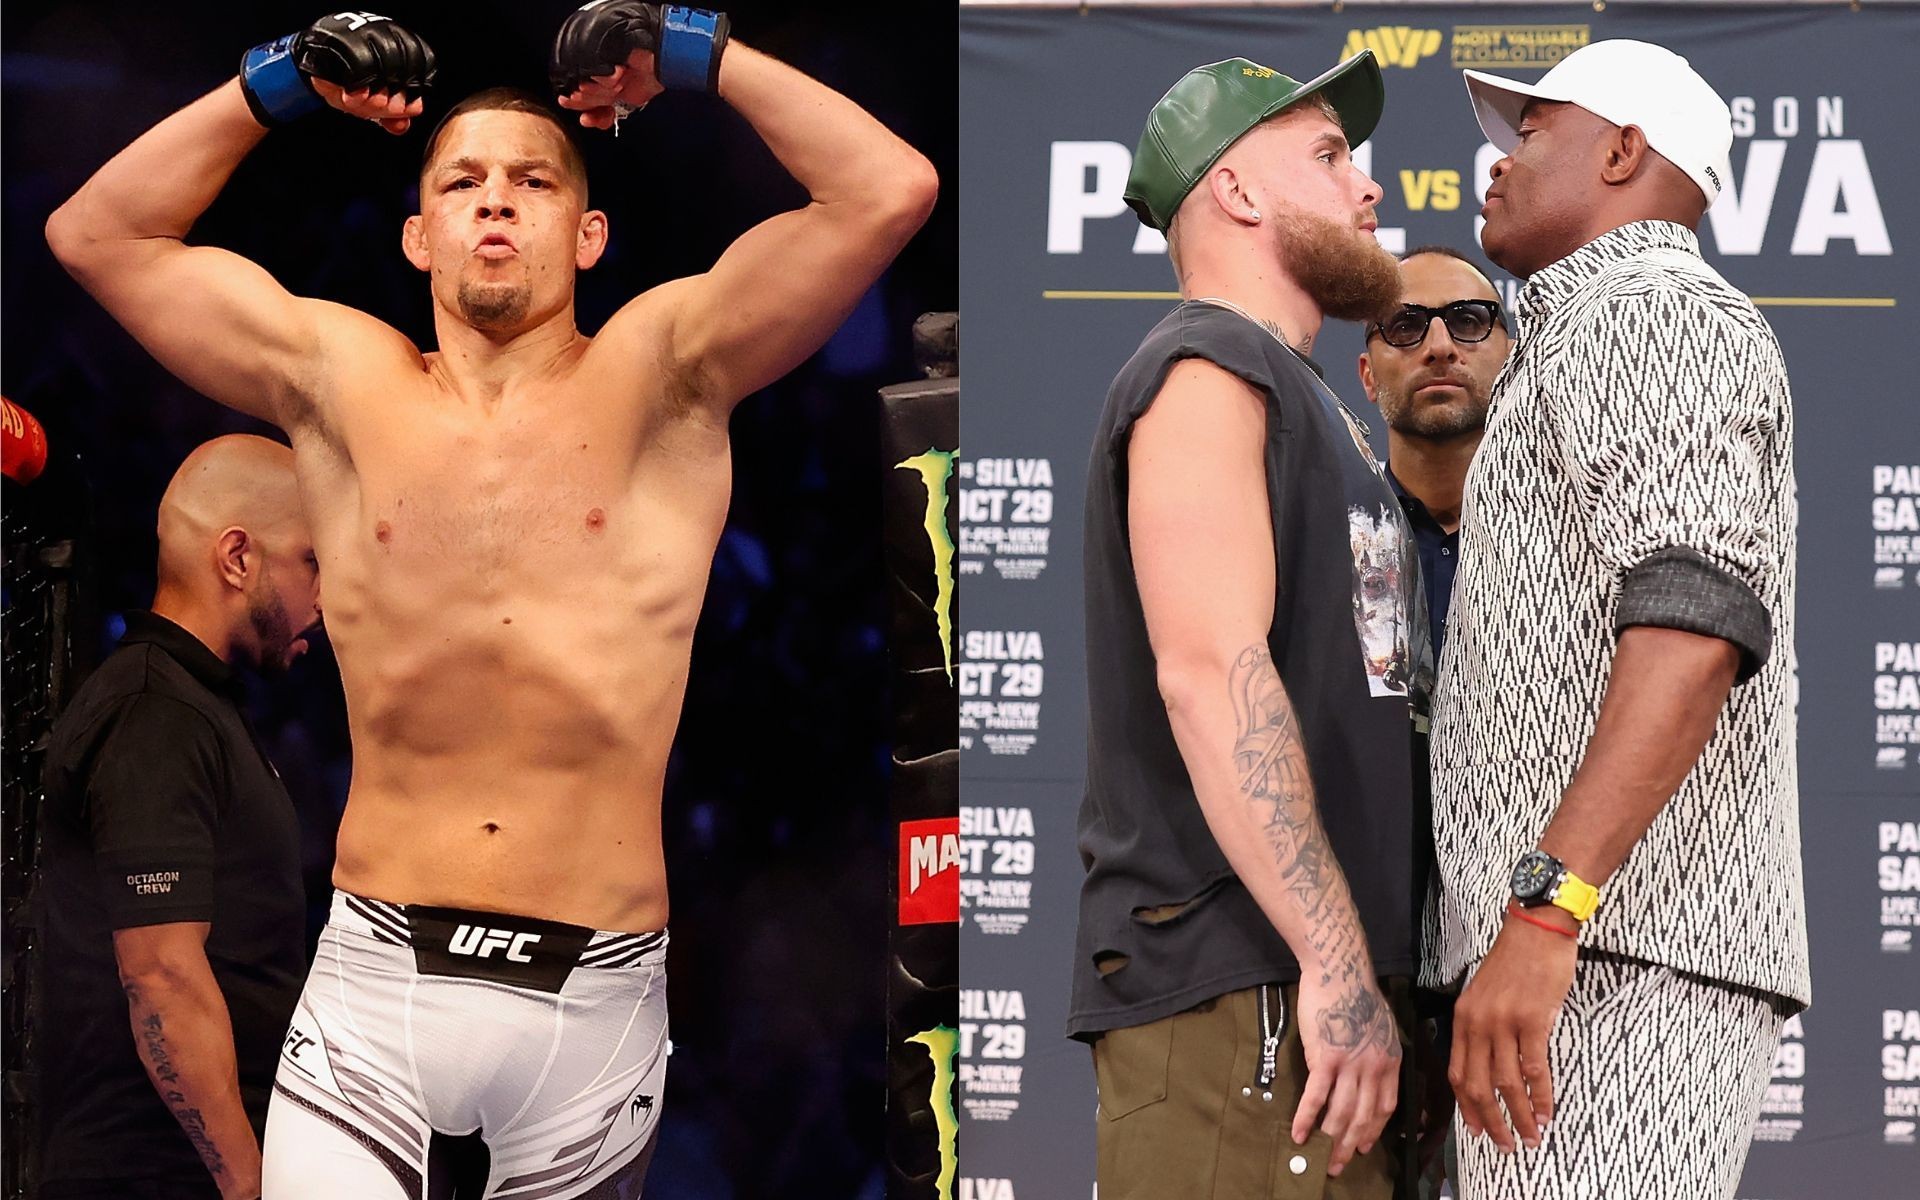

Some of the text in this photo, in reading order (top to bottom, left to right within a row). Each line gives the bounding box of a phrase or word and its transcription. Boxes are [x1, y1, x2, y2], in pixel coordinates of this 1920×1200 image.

[1452, 30, 1589, 45] MOST VALUABLE
[1400, 169, 1460, 212] VS
[976, 458, 1053, 487] SILVA
[1010, 489, 1053, 523] 29
[965, 630, 1044, 660] SILVA
[1000, 663, 1044, 697] 29
[960, 806, 1035, 836] SILVA
[991, 840, 1035, 874] 29
[127, 872, 179, 885] OCTAGON
[136, 883, 171, 895] CREW
[448, 924, 542, 963] UFC
[981, 1023, 1026, 1060] 29
